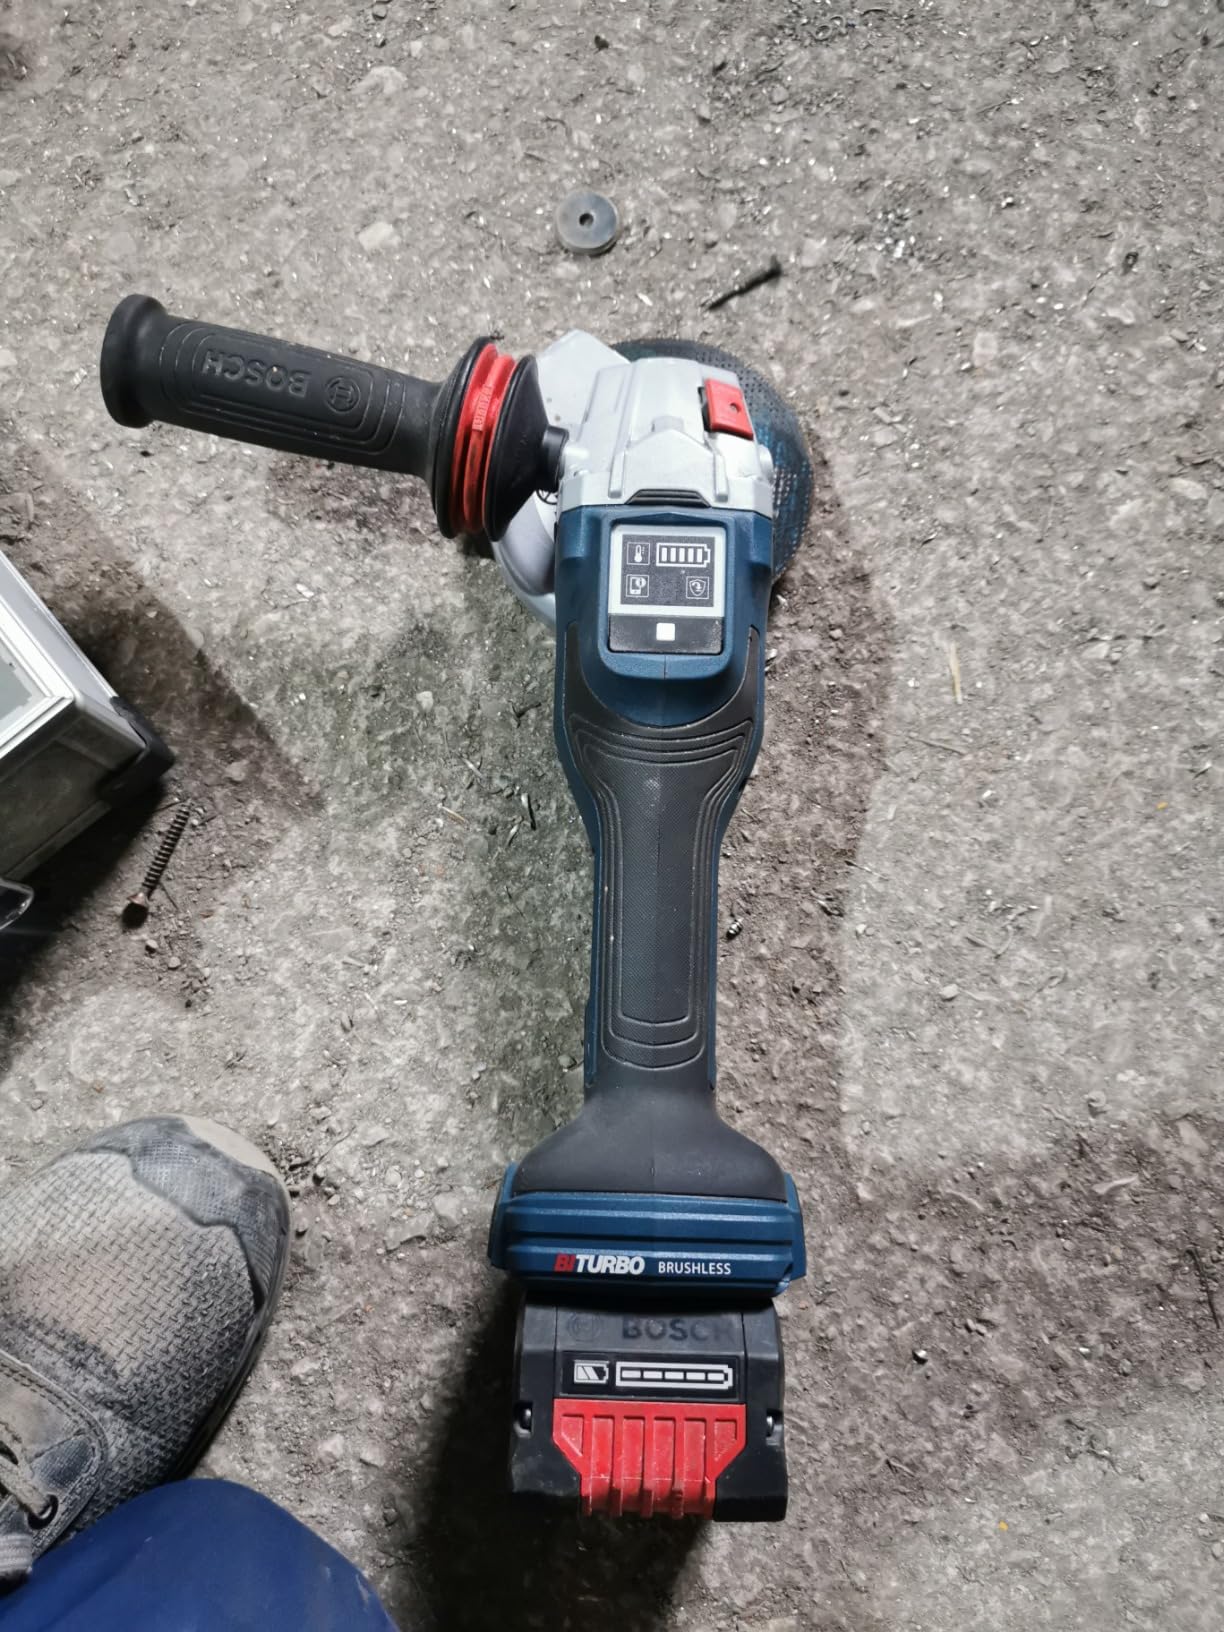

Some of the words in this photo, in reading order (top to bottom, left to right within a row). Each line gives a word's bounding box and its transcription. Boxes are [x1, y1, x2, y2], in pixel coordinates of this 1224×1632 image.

[202, 349, 311, 398] BOSCH
[554, 1254, 646, 1275] BITURBO
[658, 1261, 732, 1275] BRUSHLESS
[622, 1316, 735, 1341] BOSCH
